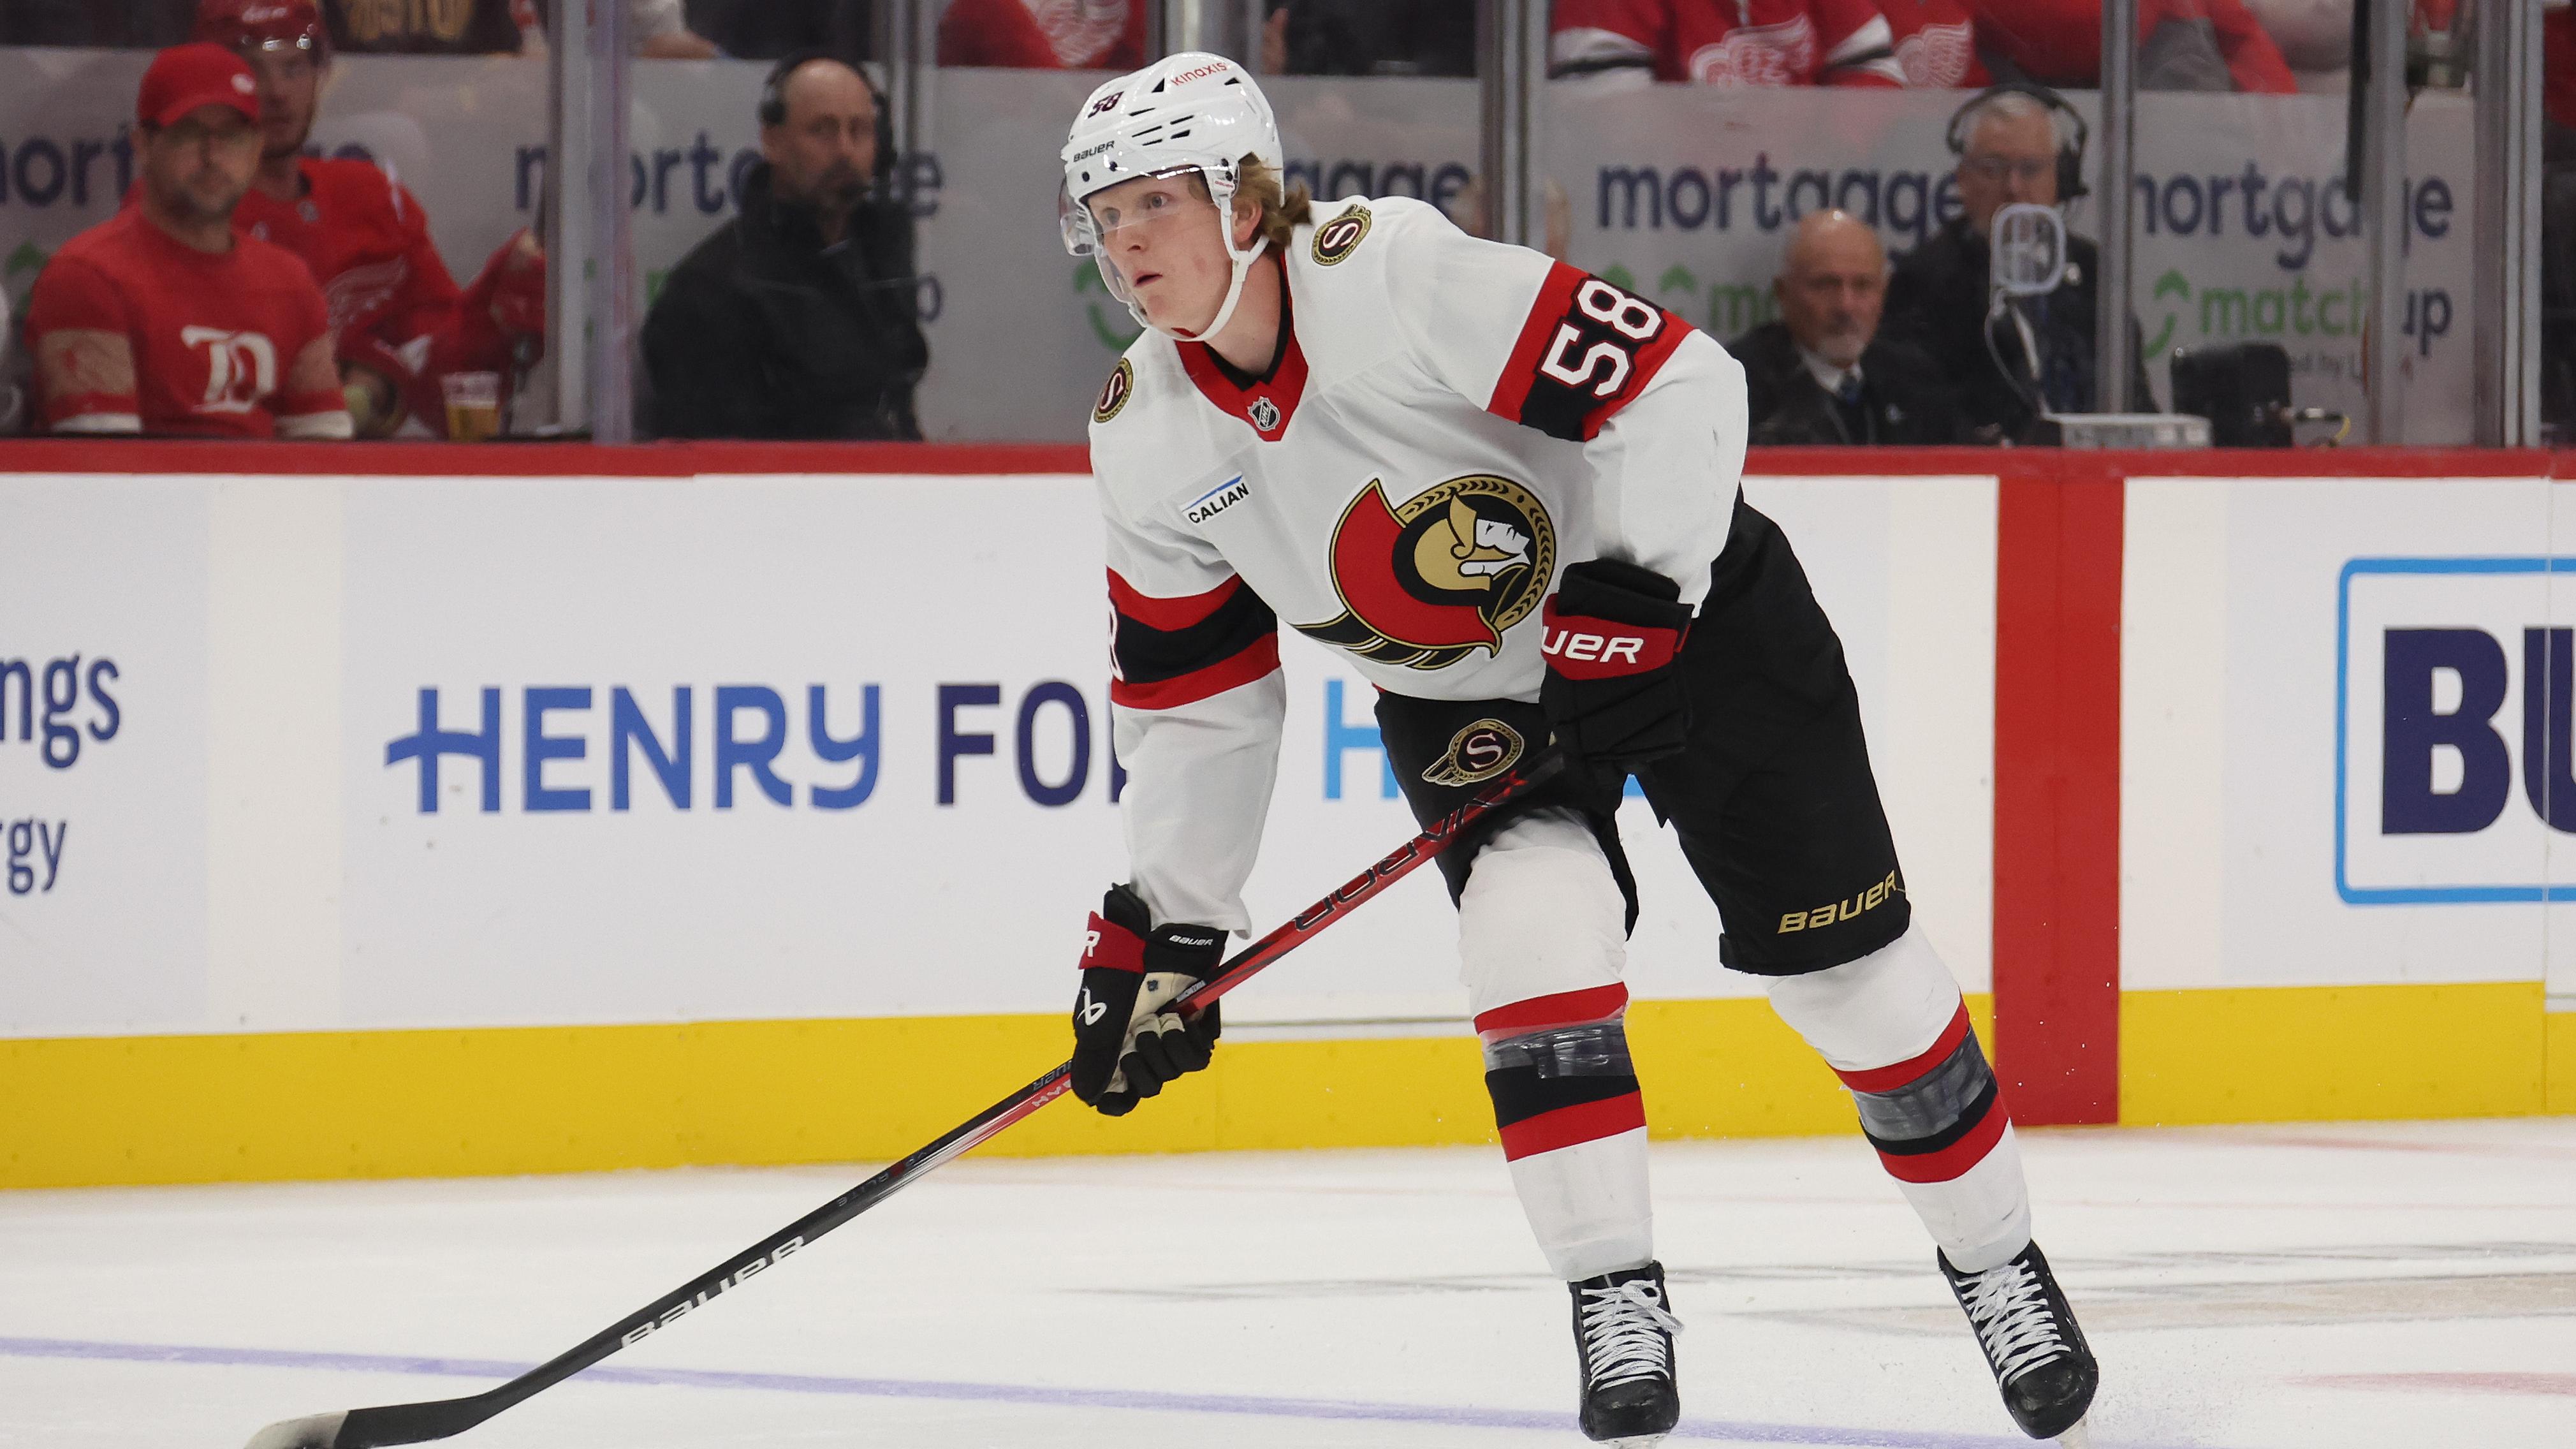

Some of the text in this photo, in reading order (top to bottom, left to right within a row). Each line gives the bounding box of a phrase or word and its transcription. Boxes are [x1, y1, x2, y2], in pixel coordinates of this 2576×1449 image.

[1088, 91, 1124, 119] 58
[1537, 278, 1664, 398] 58
[1188, 482, 1249, 524] CALIAN
[384, 683, 880, 813] HENRY
